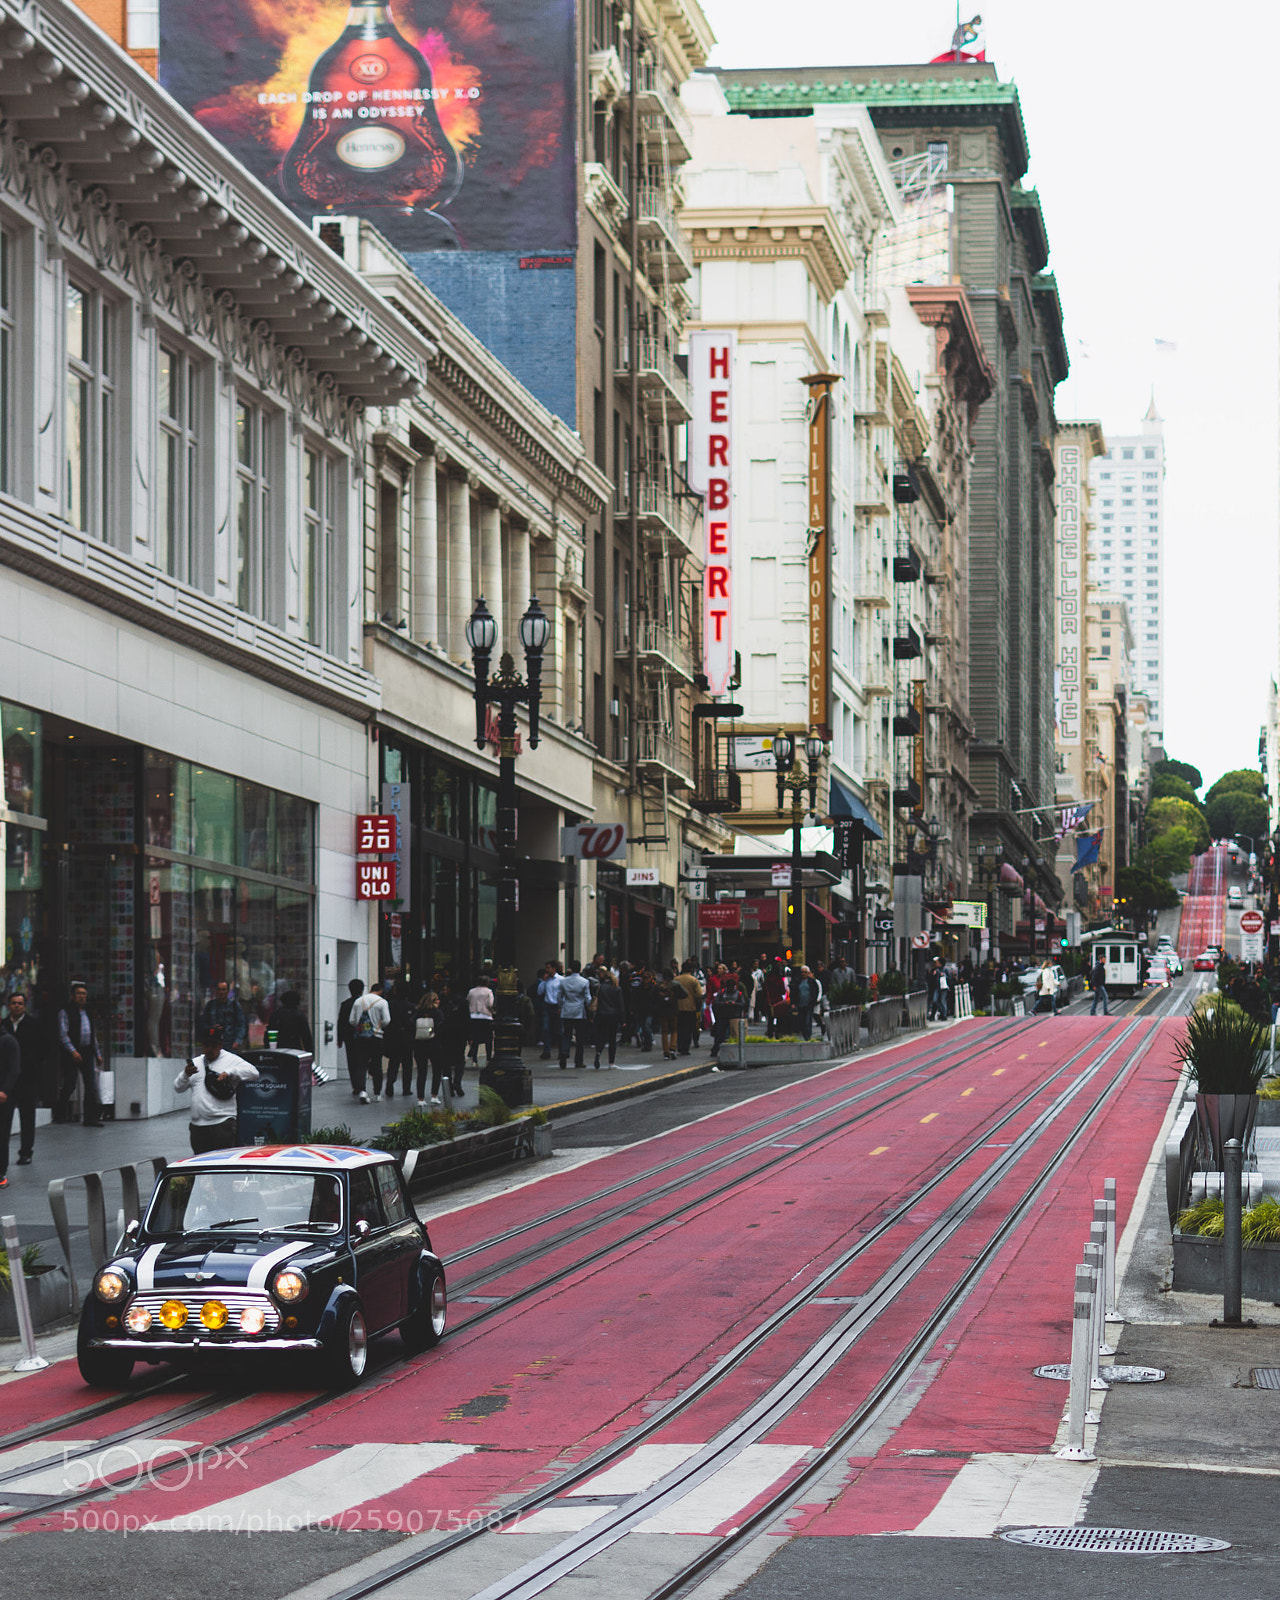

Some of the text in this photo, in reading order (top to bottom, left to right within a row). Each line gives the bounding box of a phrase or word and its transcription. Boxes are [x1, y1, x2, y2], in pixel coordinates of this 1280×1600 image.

[257, 91, 297, 104] EACH
[301, 90, 342, 103] DROP
[346, 89, 368, 102] OF
[372, 87, 449, 101] HENNESSY
[312, 105, 425, 120] IS AN ODYSSEY
[345, 140, 396, 154] Hennessy
[805, 391, 829, 521] VILLA
[709, 347, 729, 642] HERBERT
[1061, 448, 1078, 739] CHANCELLOR HOTEL
[804, 525, 825, 716] FLORENCE
[361, 866, 388, 880] UNI
[631, 872, 654, 881] JINS
[361, 882, 391, 897] QLO
